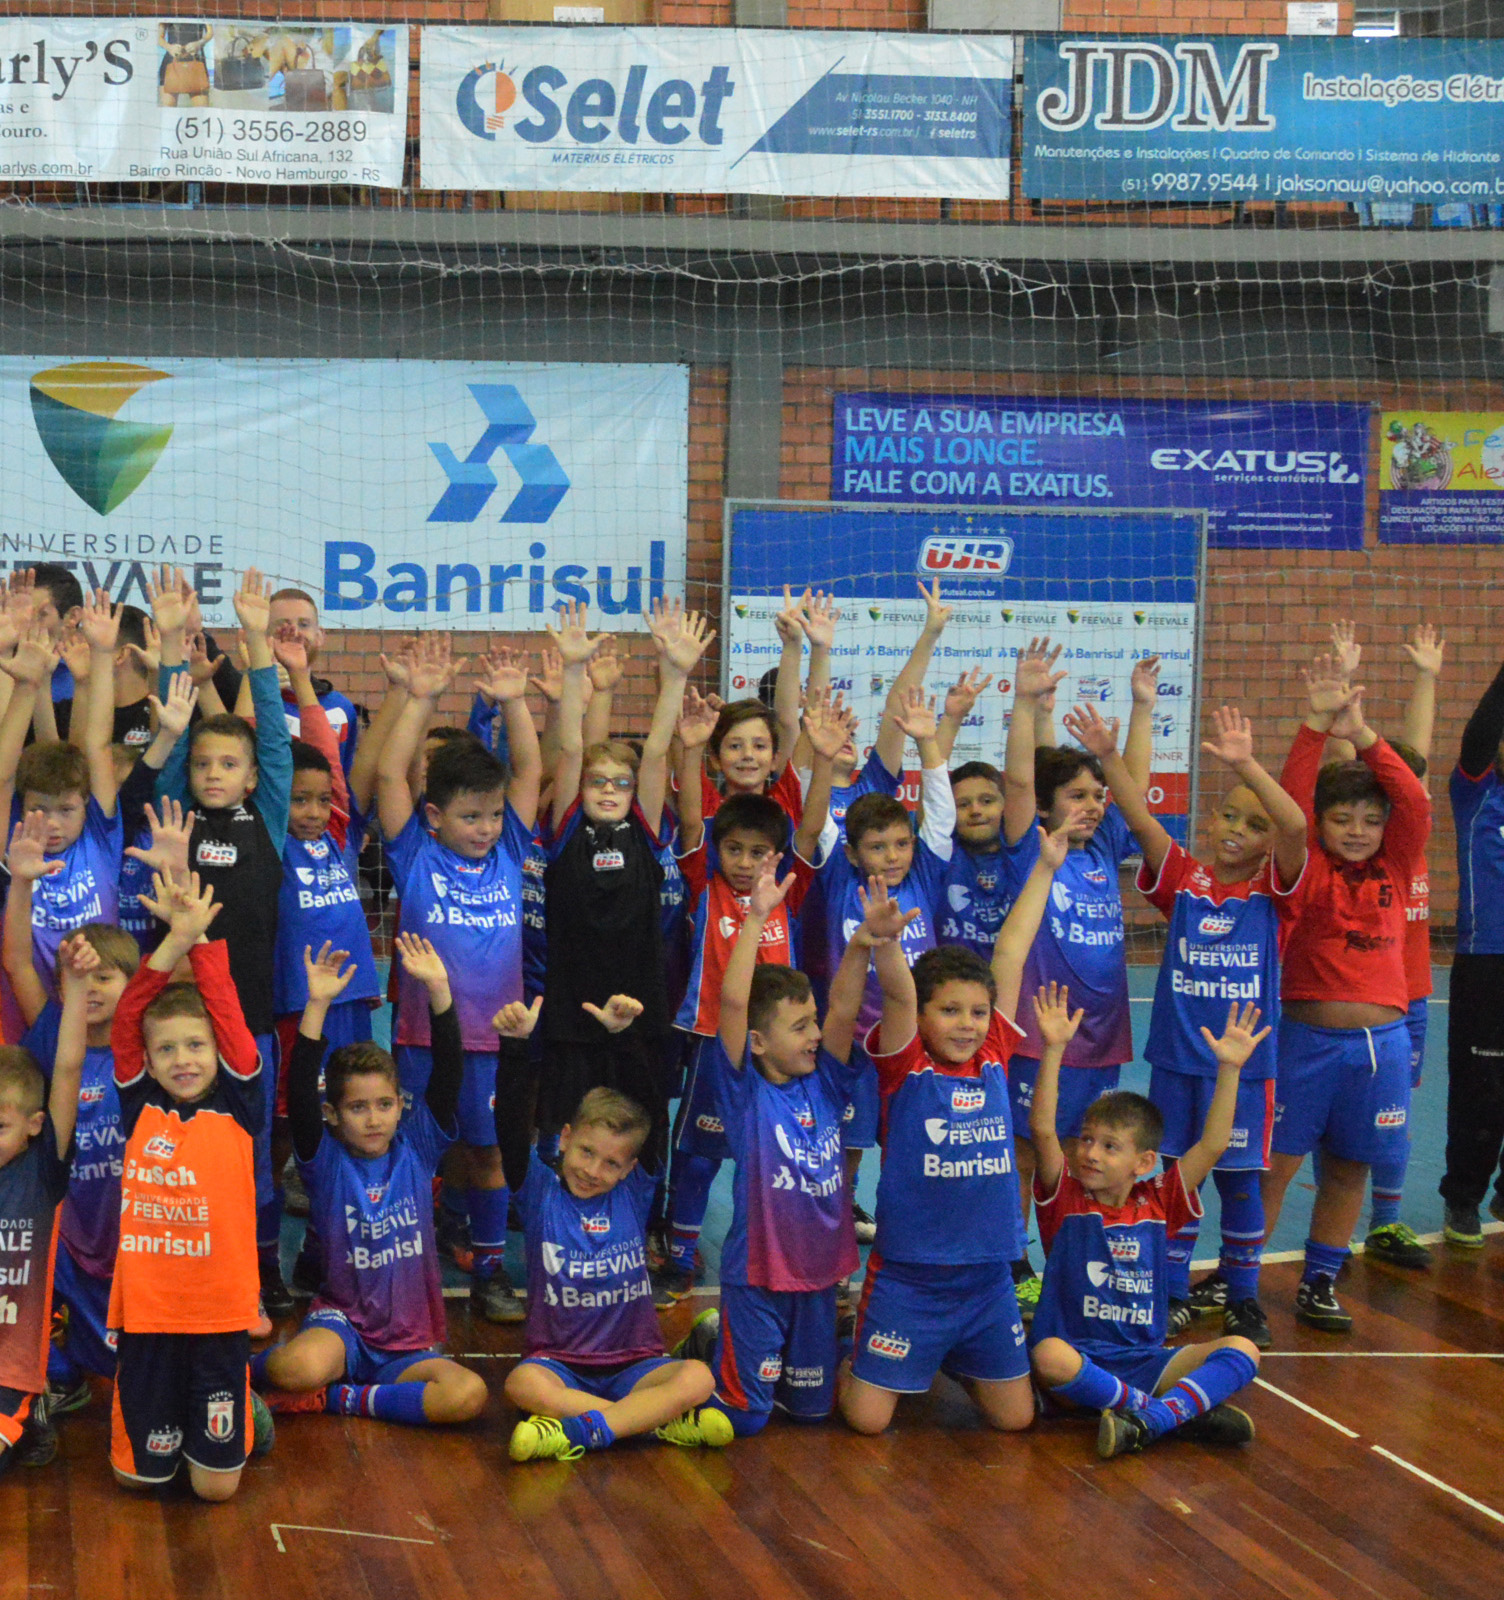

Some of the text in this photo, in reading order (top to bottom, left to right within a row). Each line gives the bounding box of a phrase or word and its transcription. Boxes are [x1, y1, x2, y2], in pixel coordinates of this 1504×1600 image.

[1036, 41, 1280, 132] JDM
[1304, 74, 1442, 106] Instalações
[19, 103, 30, 115] e
[513, 64, 736, 145] Selet
[961, 95, 979, 107] NH
[175, 116, 368, 144] (51) 3556-2889
[938, 127, 977, 140] seletrs
[160, 146, 353, 164] Rua União Sul Africana, 132
[551, 151, 675, 165] MATERIAIS ELÉTRICOS
[1034, 144, 1501, 164] Manutenções e Instalações Quadro de Comando Sistema de Hidrante
[130, 163, 381, 183] Bairro Rincão Novo Hamburgo RS
[1121, 177, 1148, 192] (51)
[1151, 172, 1259, 191] 9987.9544
[846, 407, 1126, 437] LEVE A SUA EMPRESA
[845, 436, 1044, 466] MAIS LONGE.
[1150, 448, 1327, 474] EXATUS
[844, 469, 1114, 498] FALE COM A EXATUS.
[1214, 472, 1326, 485] serviços contábeis
[1391, 506, 1447, 516] DECORAÇÕES
[1421, 498, 1457, 506] ARTIGOS
[925, 543, 1005, 570] UJR
[323, 540, 666, 615] Banrisul
[883, 613, 926, 623] FEEVALE
[1016, 615, 1058, 625] FEEVALE
[1081, 616, 1124, 626] FEEVALE
[1147, 617, 1189, 627] FEEVALE
[944, 646, 993, 658] Banrisul
[1075, 648, 1124, 660] Banrisul
[1189, 942, 1259, 953] UNIVERSIDADE
[1188, 951, 1260, 968] FEEVALE
[1171, 969, 1261, 1000] Banrisul
[126, 1159, 197, 1187] GuSch
[924, 1148, 1012, 1179] Banrisul
[134, 1192, 208, 1205] UNIVERSIDADE
[133, 1201, 209, 1222] FEEVALE
[568, 1248, 646, 1279] FEEVALE
[562, 1269, 653, 1310] Banrisul
